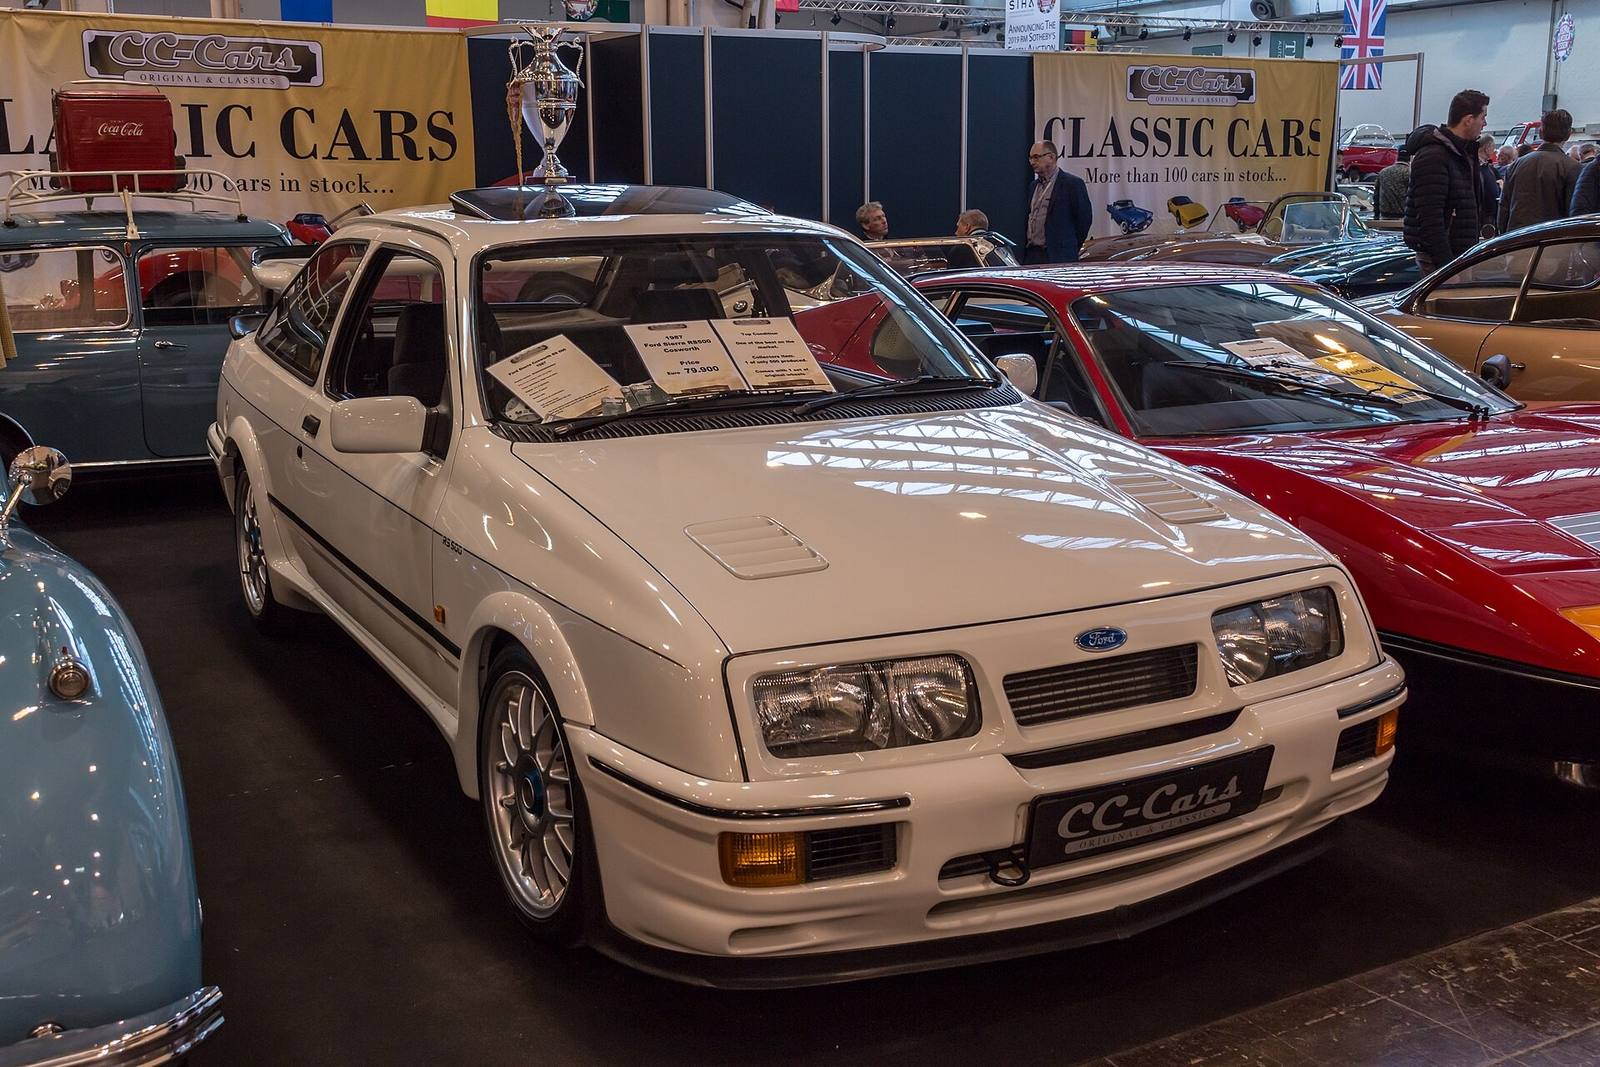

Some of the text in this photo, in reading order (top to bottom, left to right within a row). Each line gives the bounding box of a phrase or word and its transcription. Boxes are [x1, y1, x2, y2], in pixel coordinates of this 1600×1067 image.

[108, 31, 302, 73] CC-Cars
[139, 74, 200, 83] ORIGINAL
[219, 76, 276, 85] CLASSICS
[1140, 65, 1245, 94] CC-Cars
[279, 106, 458, 162] CARS
[1043, 116, 1321, 158] CLASSIC CARS
[223, 176, 271, 193] cars
[280, 172, 300, 192] in
[309, 174, 394, 194] stock...
[1085, 166, 1287, 184] More than 100 cars in stock...
[663, 340, 687, 348] Sierra
[663, 345, 700, 354] Cosworth
[683, 365, 720, 374] 79.900
[1089, 631, 1116, 646] Ford
[1057, 775, 1242, 839] CC-Cars
[1079, 831, 1141, 849] ORIGINAL
